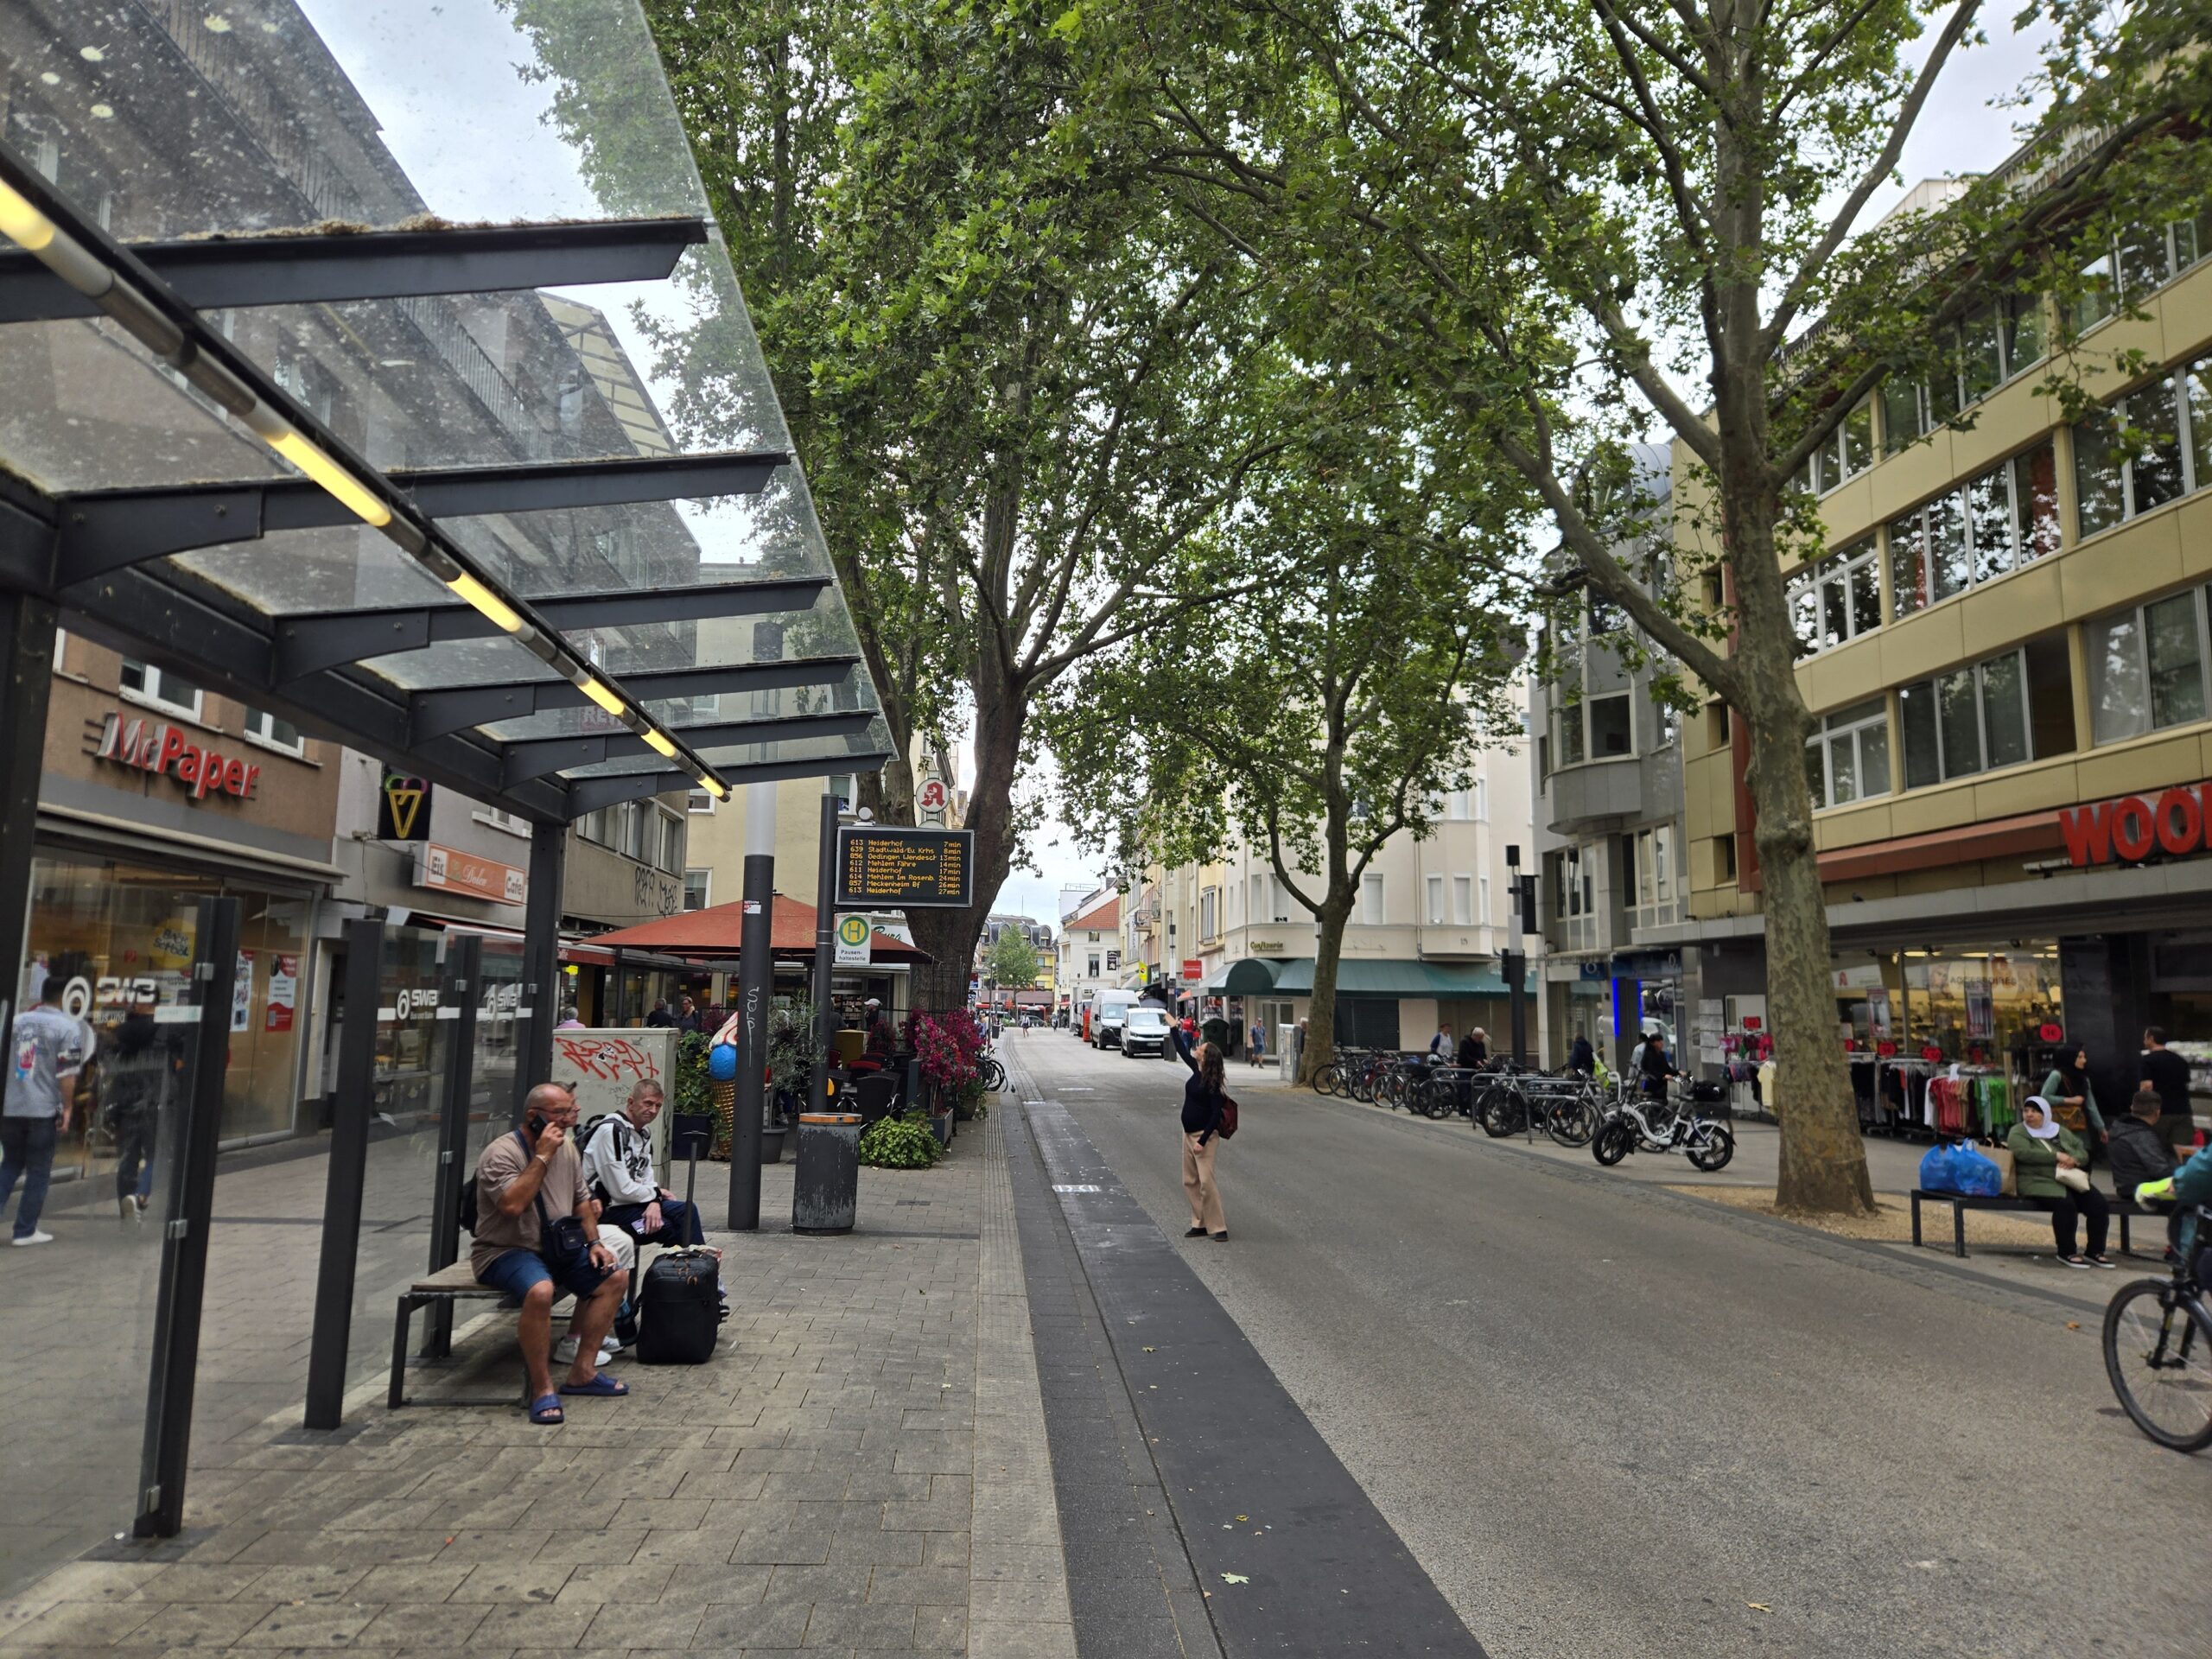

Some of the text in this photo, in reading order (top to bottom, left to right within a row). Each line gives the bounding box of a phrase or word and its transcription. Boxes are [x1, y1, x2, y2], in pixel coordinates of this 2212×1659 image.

[97, 711, 259, 799] McPaper
[432, 856, 445, 877] Eis
[411, 988, 439, 1007] SWB
